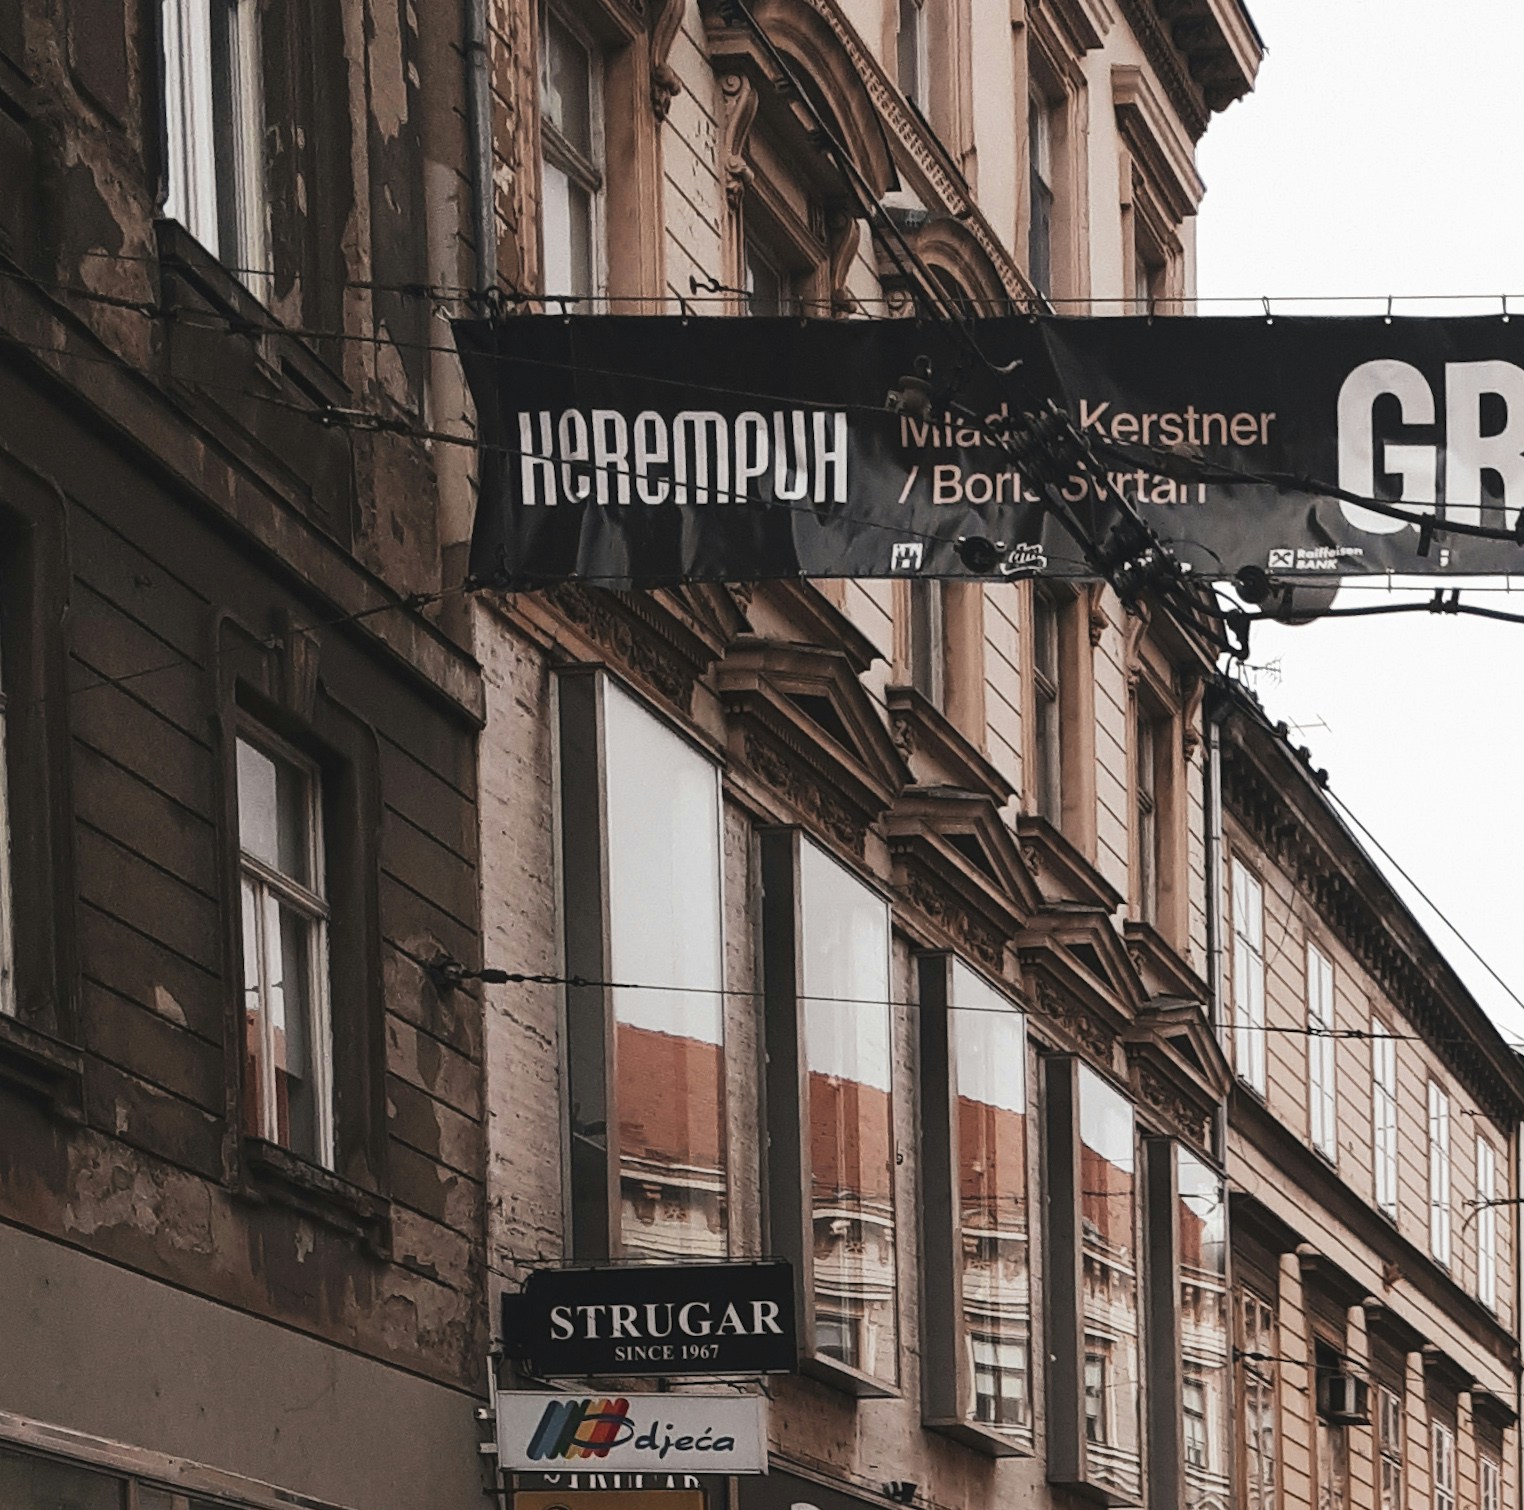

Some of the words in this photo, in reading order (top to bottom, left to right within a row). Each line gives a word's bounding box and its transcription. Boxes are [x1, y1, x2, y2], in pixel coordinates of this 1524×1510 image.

[1079, 399, 1278, 447] Kerstner
[1296, 559, 1338, 570] BANK
[550, 1299, 784, 1341] STRUGAR
[615, 1344, 675, 1361] SINCE
[680, 1343, 720, 1360] 1967
